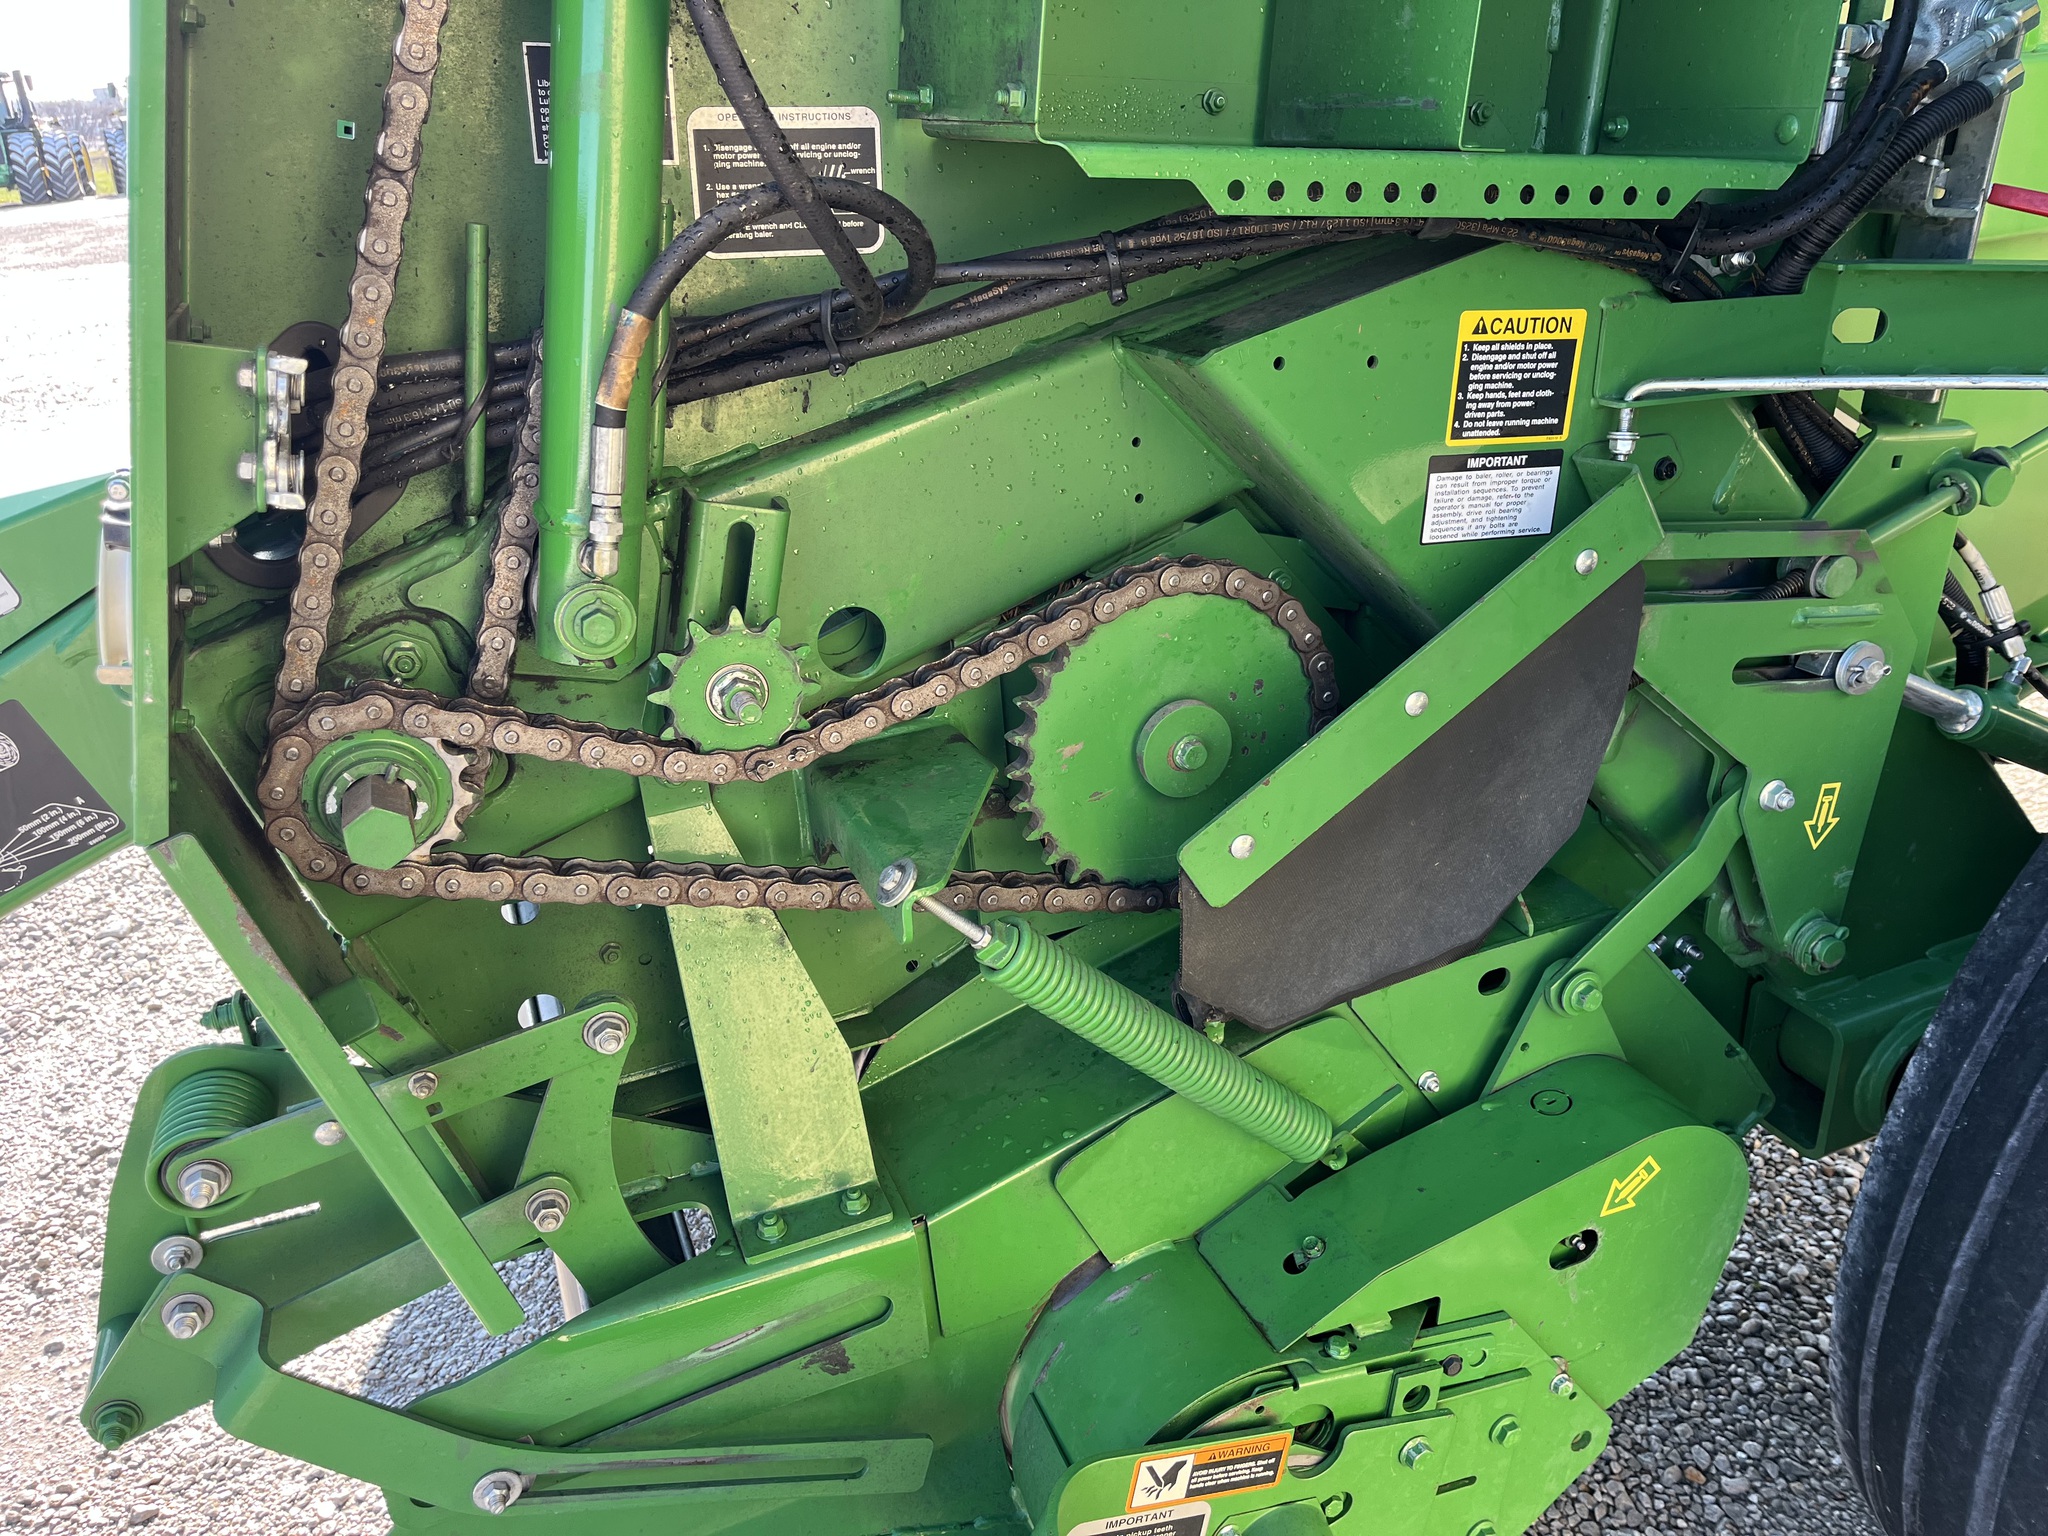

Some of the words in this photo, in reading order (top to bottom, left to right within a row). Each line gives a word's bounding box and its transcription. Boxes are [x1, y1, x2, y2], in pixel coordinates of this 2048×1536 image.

[778, 112, 851, 121] INSTRUCTIONS
[702, 144, 710, 152] 1.
[811, 143, 836, 151] engine
[837, 142, 861, 150] and/or
[713, 152, 736, 160] motor
[737, 152, 760, 161] power
[833, 151, 861, 159] unclog-
[732, 160, 767, 168] machine.
[706, 183, 713, 191] 2.
[715, 183, 730, 191] Use
[752, 222, 777, 230] wrench
[842, 220, 864, 228] before
[1271, 222, 1290, 232] SAE
[1174, 230, 1204, 241] 18752
[1207, 228, 1222, 238] ISO
[1046, 246, 1090, 259] Resistant
[1490, 316, 1573, 335] CAUTION
[1463, 344, 1470, 352] 1.
[1472, 343, 1490, 353] Keep
[1491, 343, 1499, 351] all
[1500, 343, 1525, 351] shields
[1534, 343, 1553, 351] place.
[1462, 353, 1469, 361] 2.
[1471, 353, 1506, 362] Disengage
[1507, 352, 1520, 360] and
[1522, 352, 1537, 360] shut
[1470, 363, 1493, 372] engine
[1494, 362, 1515, 370] and/or
[1517, 362, 1536, 370] motor
[1537, 362, 1558, 370] power
[1492, 372, 1522, 381] servicing
[1532, 371, 1557, 380] unclog-
[1468, 382, 1483, 391] ging
[1467, 392, 1484, 401] Keep
[1485, 391, 1507, 400] hands,
[1466, 402, 1476, 410] ing
[1496, 400, 1511, 408] from
[1512, 401, 1535, 409] power-
[1486, 410, 1505, 418] parts.
[1463, 420, 1473, 428] Do
[1486, 419, 1503, 427] leave
[1504, 419, 1530, 427] running
[1531, 417, 1558, 425] machine
[1462, 429, 1501, 437] unattended.
[1467, 455, 1528, 469] IMPORTANT
[1490, 478, 1518, 486] improper
[1473, 487, 1507, 495] sequences.
[1467, 494, 1494, 502] damage,
[1433, 504, 1465, 512] operator's
[1431, 518, 1468, 526] adjustment,
[1430, 526, 1464, 534] sequences
[1480, 529, 1515, 538] performing
[75, 796, 85, 805] A
[18, 817, 42, 834] 50mm
[40, 813, 51, 823] (2
[49, 806, 63, 818] in.)
[32, 819, 60, 838] 100mm
[58, 815, 68, 824] (4
[67, 808, 81, 820] in.)
[49, 822, 77, 840] 150mm
[84, 812, 98, 823] in.)
[67, 827, 96, 845] 200mm
[1218, 1443, 1271, 1459] WARNING
[1105, 1509, 1175, 1529] IMPORTANT
[1154, 1524, 1173, 1533] teeth
